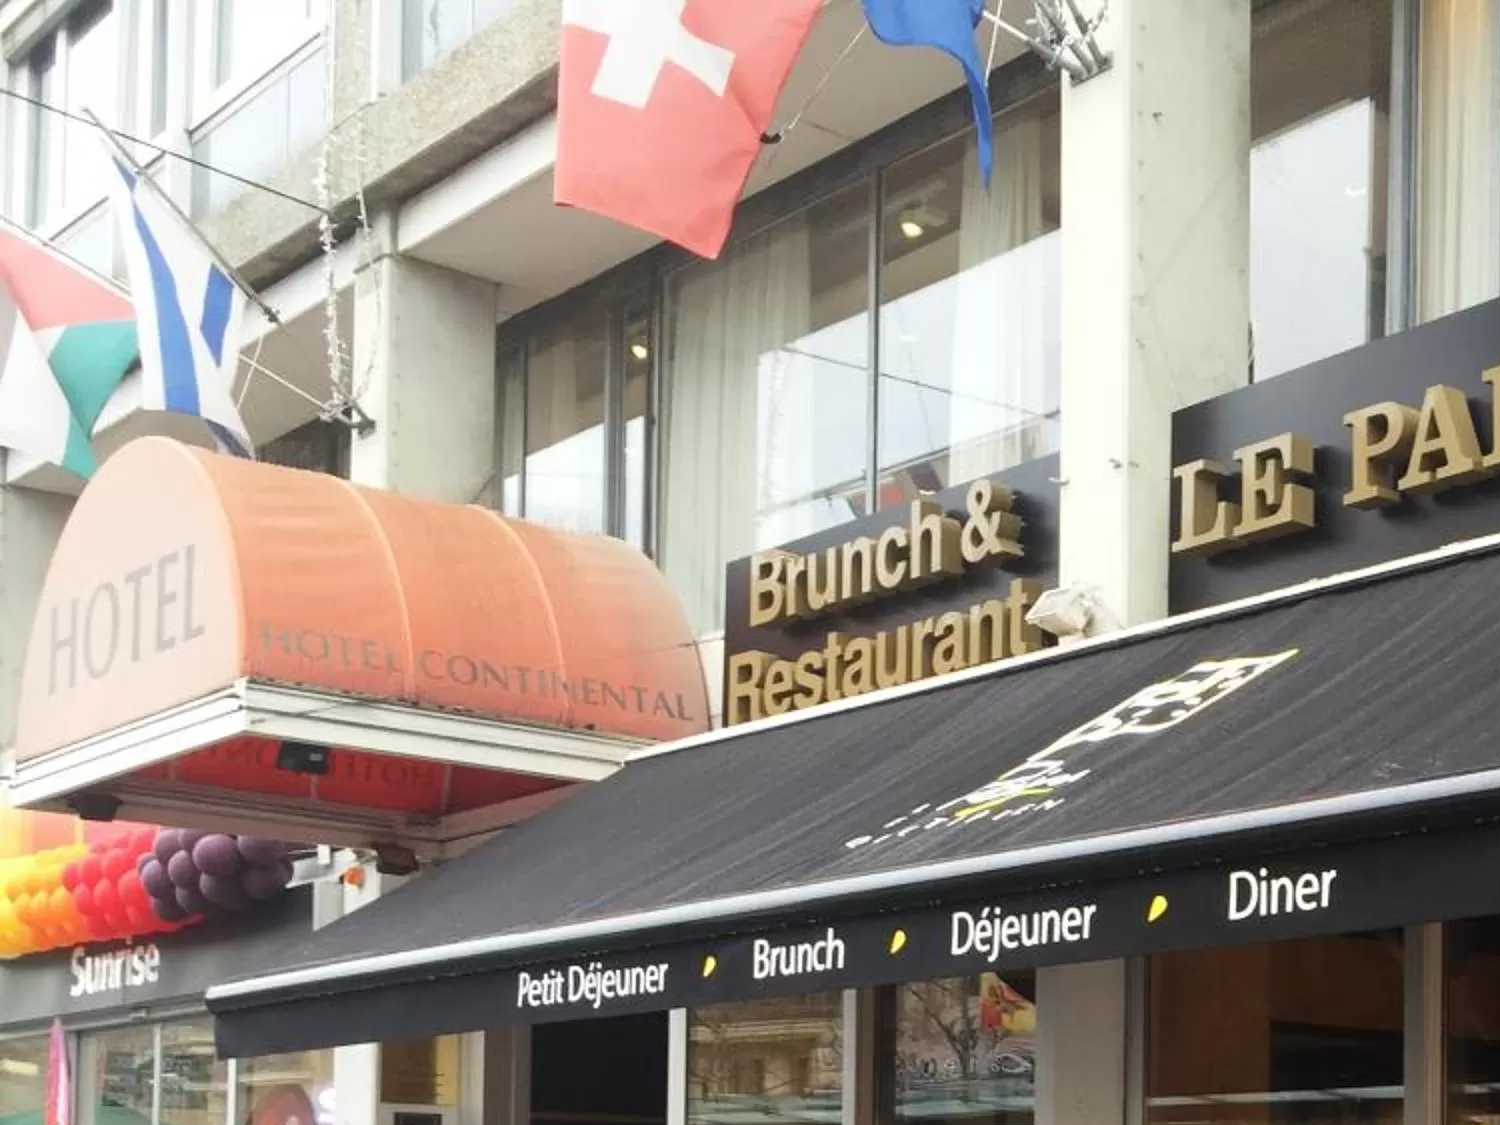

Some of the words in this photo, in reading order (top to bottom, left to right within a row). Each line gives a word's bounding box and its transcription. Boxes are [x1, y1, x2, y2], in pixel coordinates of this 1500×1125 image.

[749, 495, 962, 628] Brunch
[961, 479, 1024, 563] &
[1173, 432, 1316, 554] LE
[48, 543, 205, 697] HOTEL
[260, 621, 402, 673] HOTEL
[419, 648, 694, 722] CONTINENTAL
[728, 578, 1034, 726] Restaurant
[69, 936, 161, 997] Sunrise
[517, 970, 565, 1008] Petit
[567, 961, 669, 1009] Déjeuner
[753, 928, 845, 980] Brunch
[951, 904, 1097, 963] Déjeuner
[1228, 867, 1338, 921] Diner
